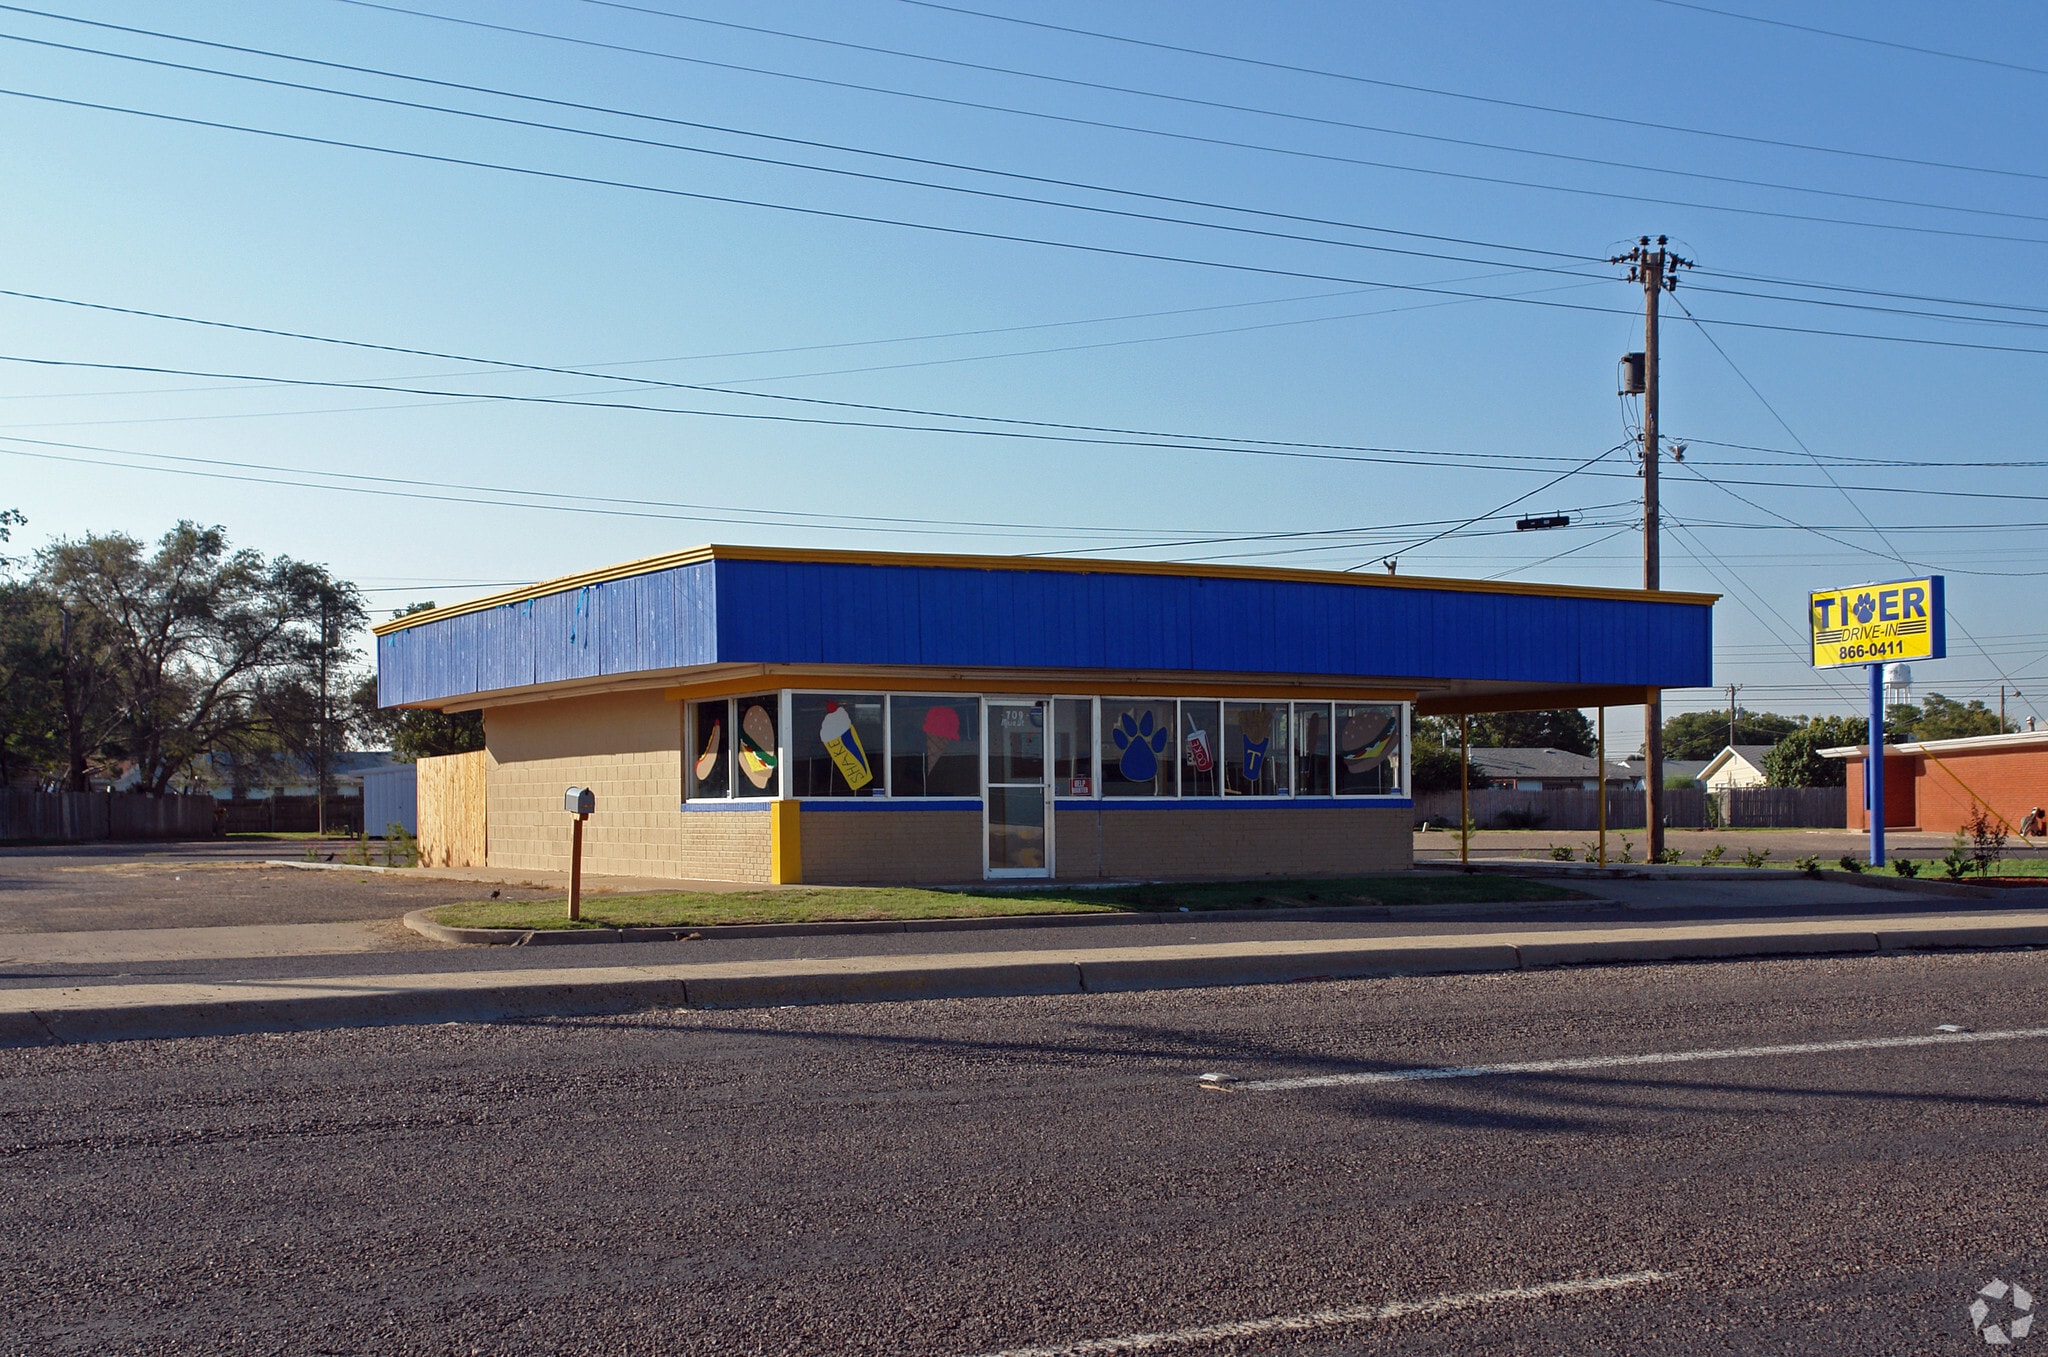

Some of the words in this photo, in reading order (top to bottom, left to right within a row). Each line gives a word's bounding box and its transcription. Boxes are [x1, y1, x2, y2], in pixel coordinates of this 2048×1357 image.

[1814, 587, 1927, 629] TIER
[1841, 622, 1899, 642] DRIVE-IN
[1839, 640, 1903, 660] 866-0411
[827, 740, 865, 783] SHAKE
[1190, 739, 1207, 767] COKE
[1247, 749, 1261, 770] T
